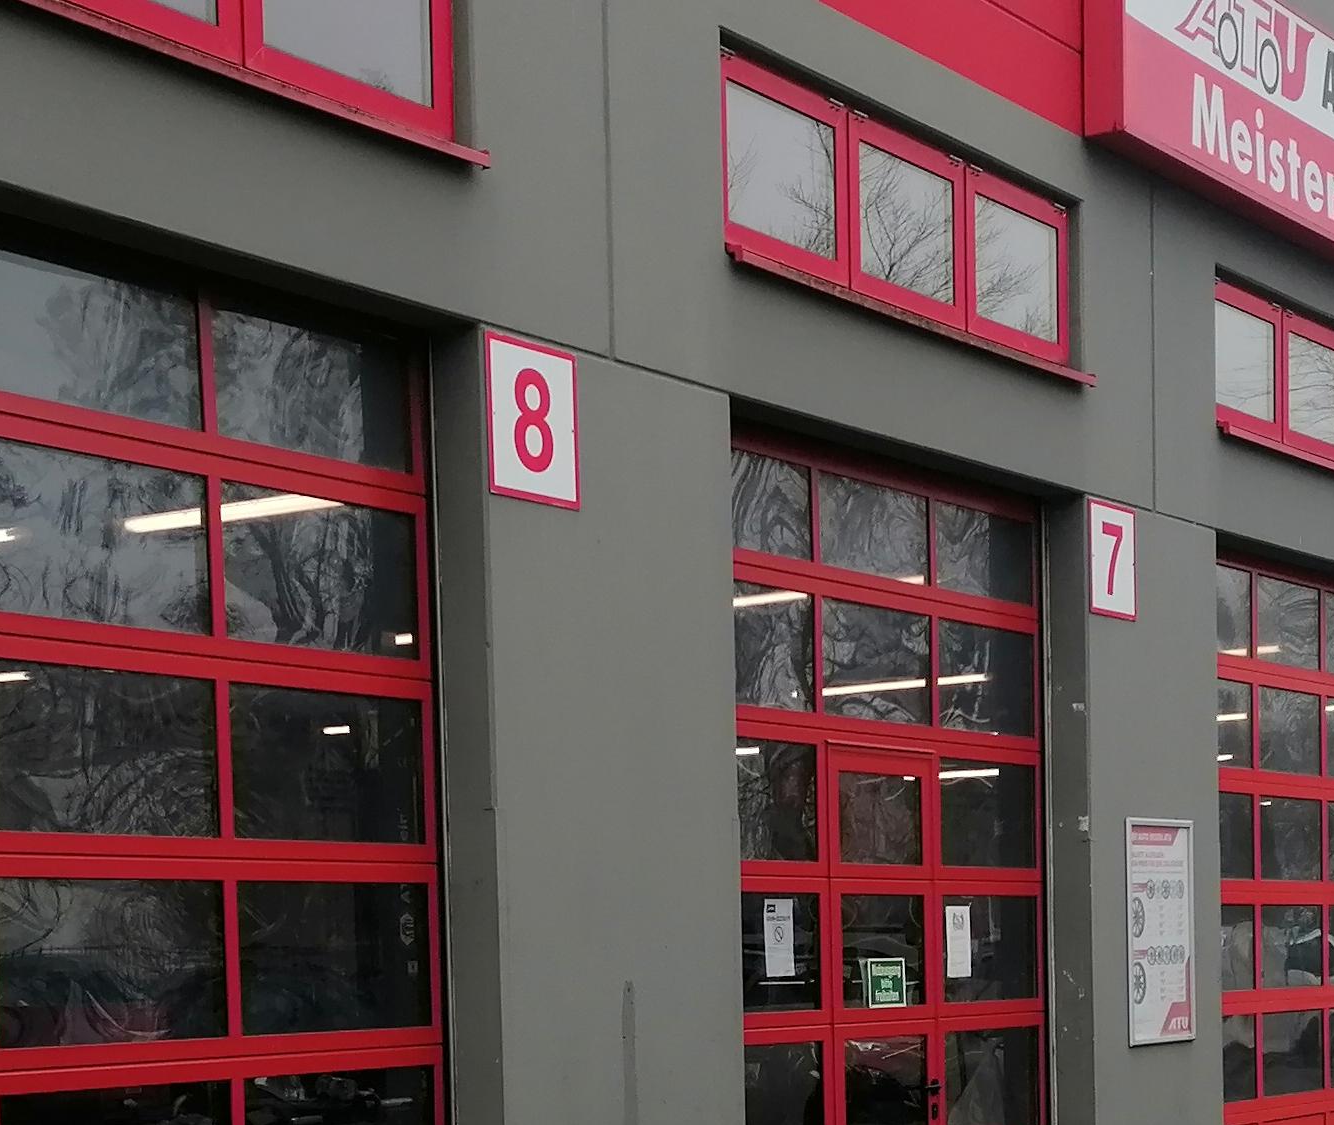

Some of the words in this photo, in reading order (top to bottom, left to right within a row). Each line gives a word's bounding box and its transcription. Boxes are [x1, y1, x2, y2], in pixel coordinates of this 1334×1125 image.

[514, 368, 554, 473] 8
[1101, 521, 1123, 596] 7
[1168, 1016, 1189, 1031] ATU
